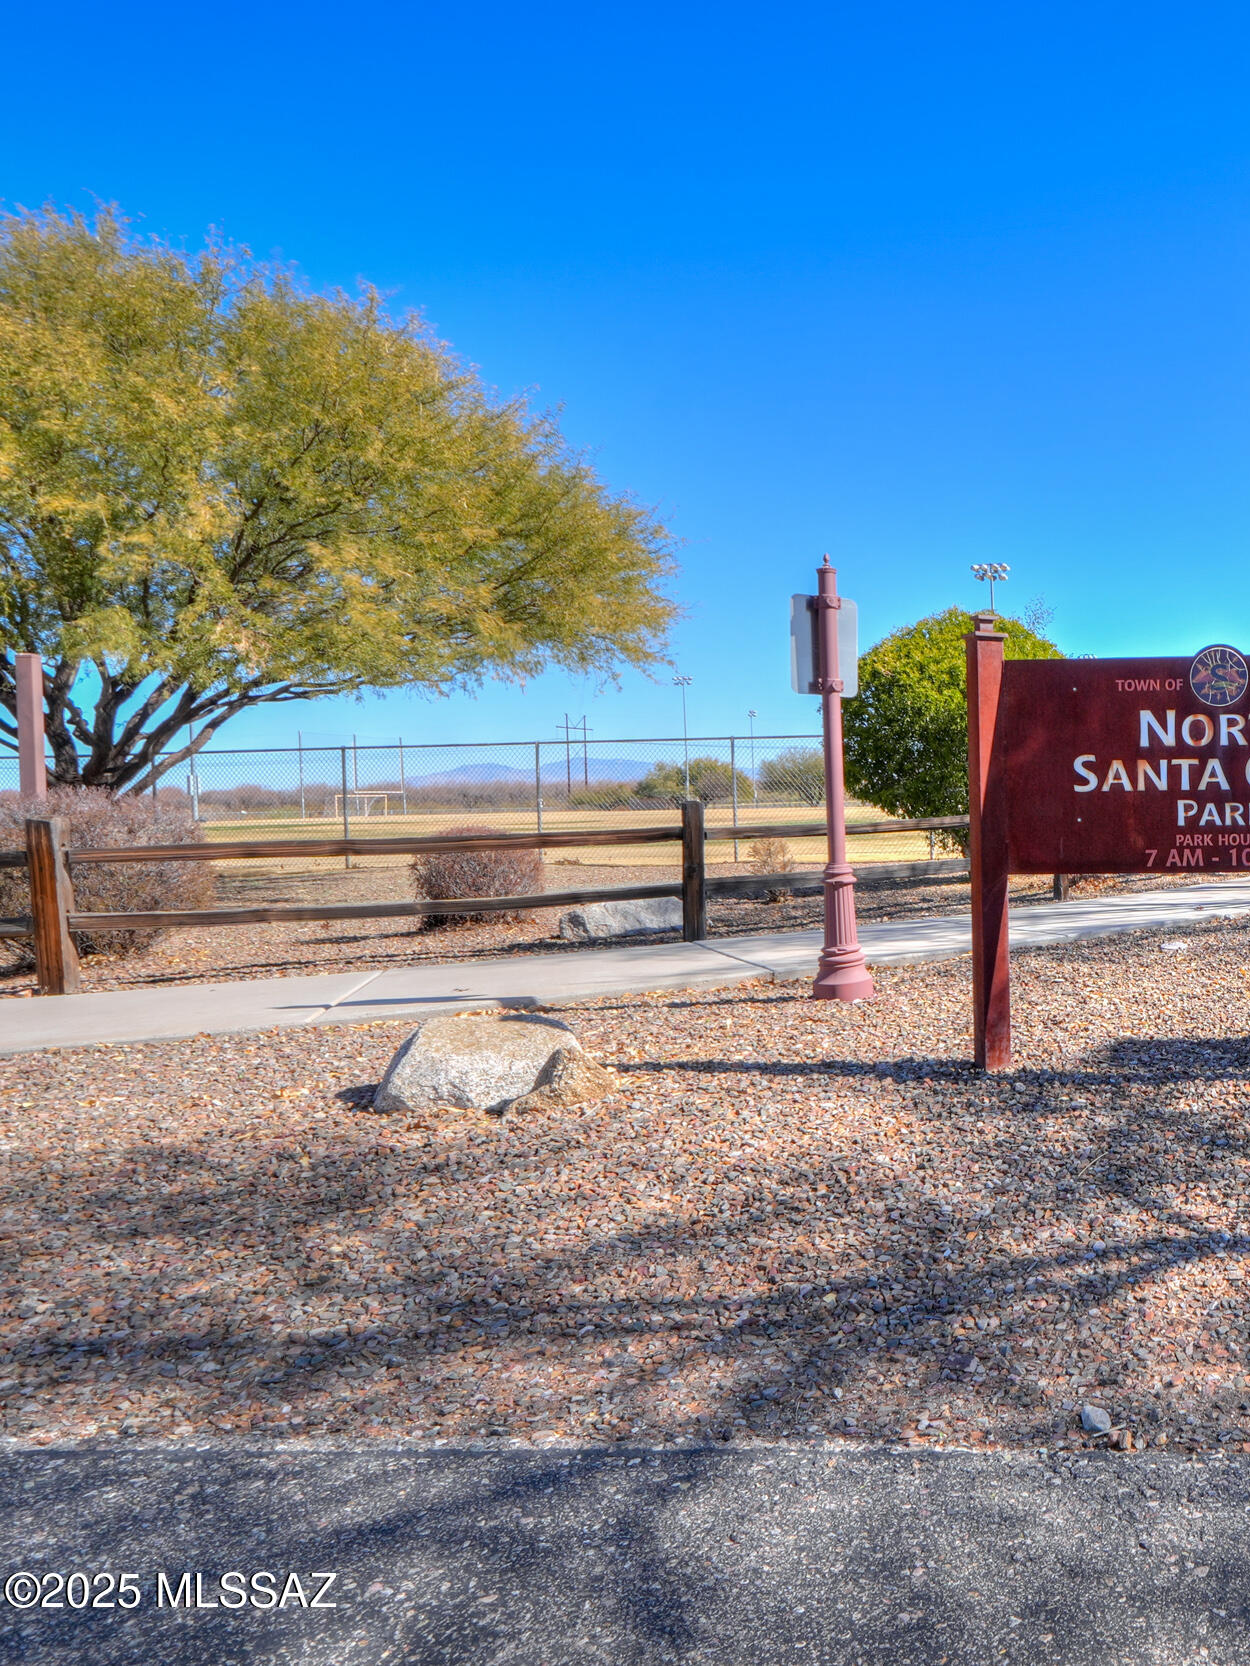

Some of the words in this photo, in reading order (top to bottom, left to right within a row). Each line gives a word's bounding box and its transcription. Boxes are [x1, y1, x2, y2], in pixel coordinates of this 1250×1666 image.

[1115, 679, 1160, 692] TOWN
[1165, 678, 1184, 691] OF
[1073, 754, 1231, 793] SANTA
[1175, 834, 1214, 847] PARK
[1145, 849, 1158, 868] 7
[1165, 848, 1205, 868] AM
